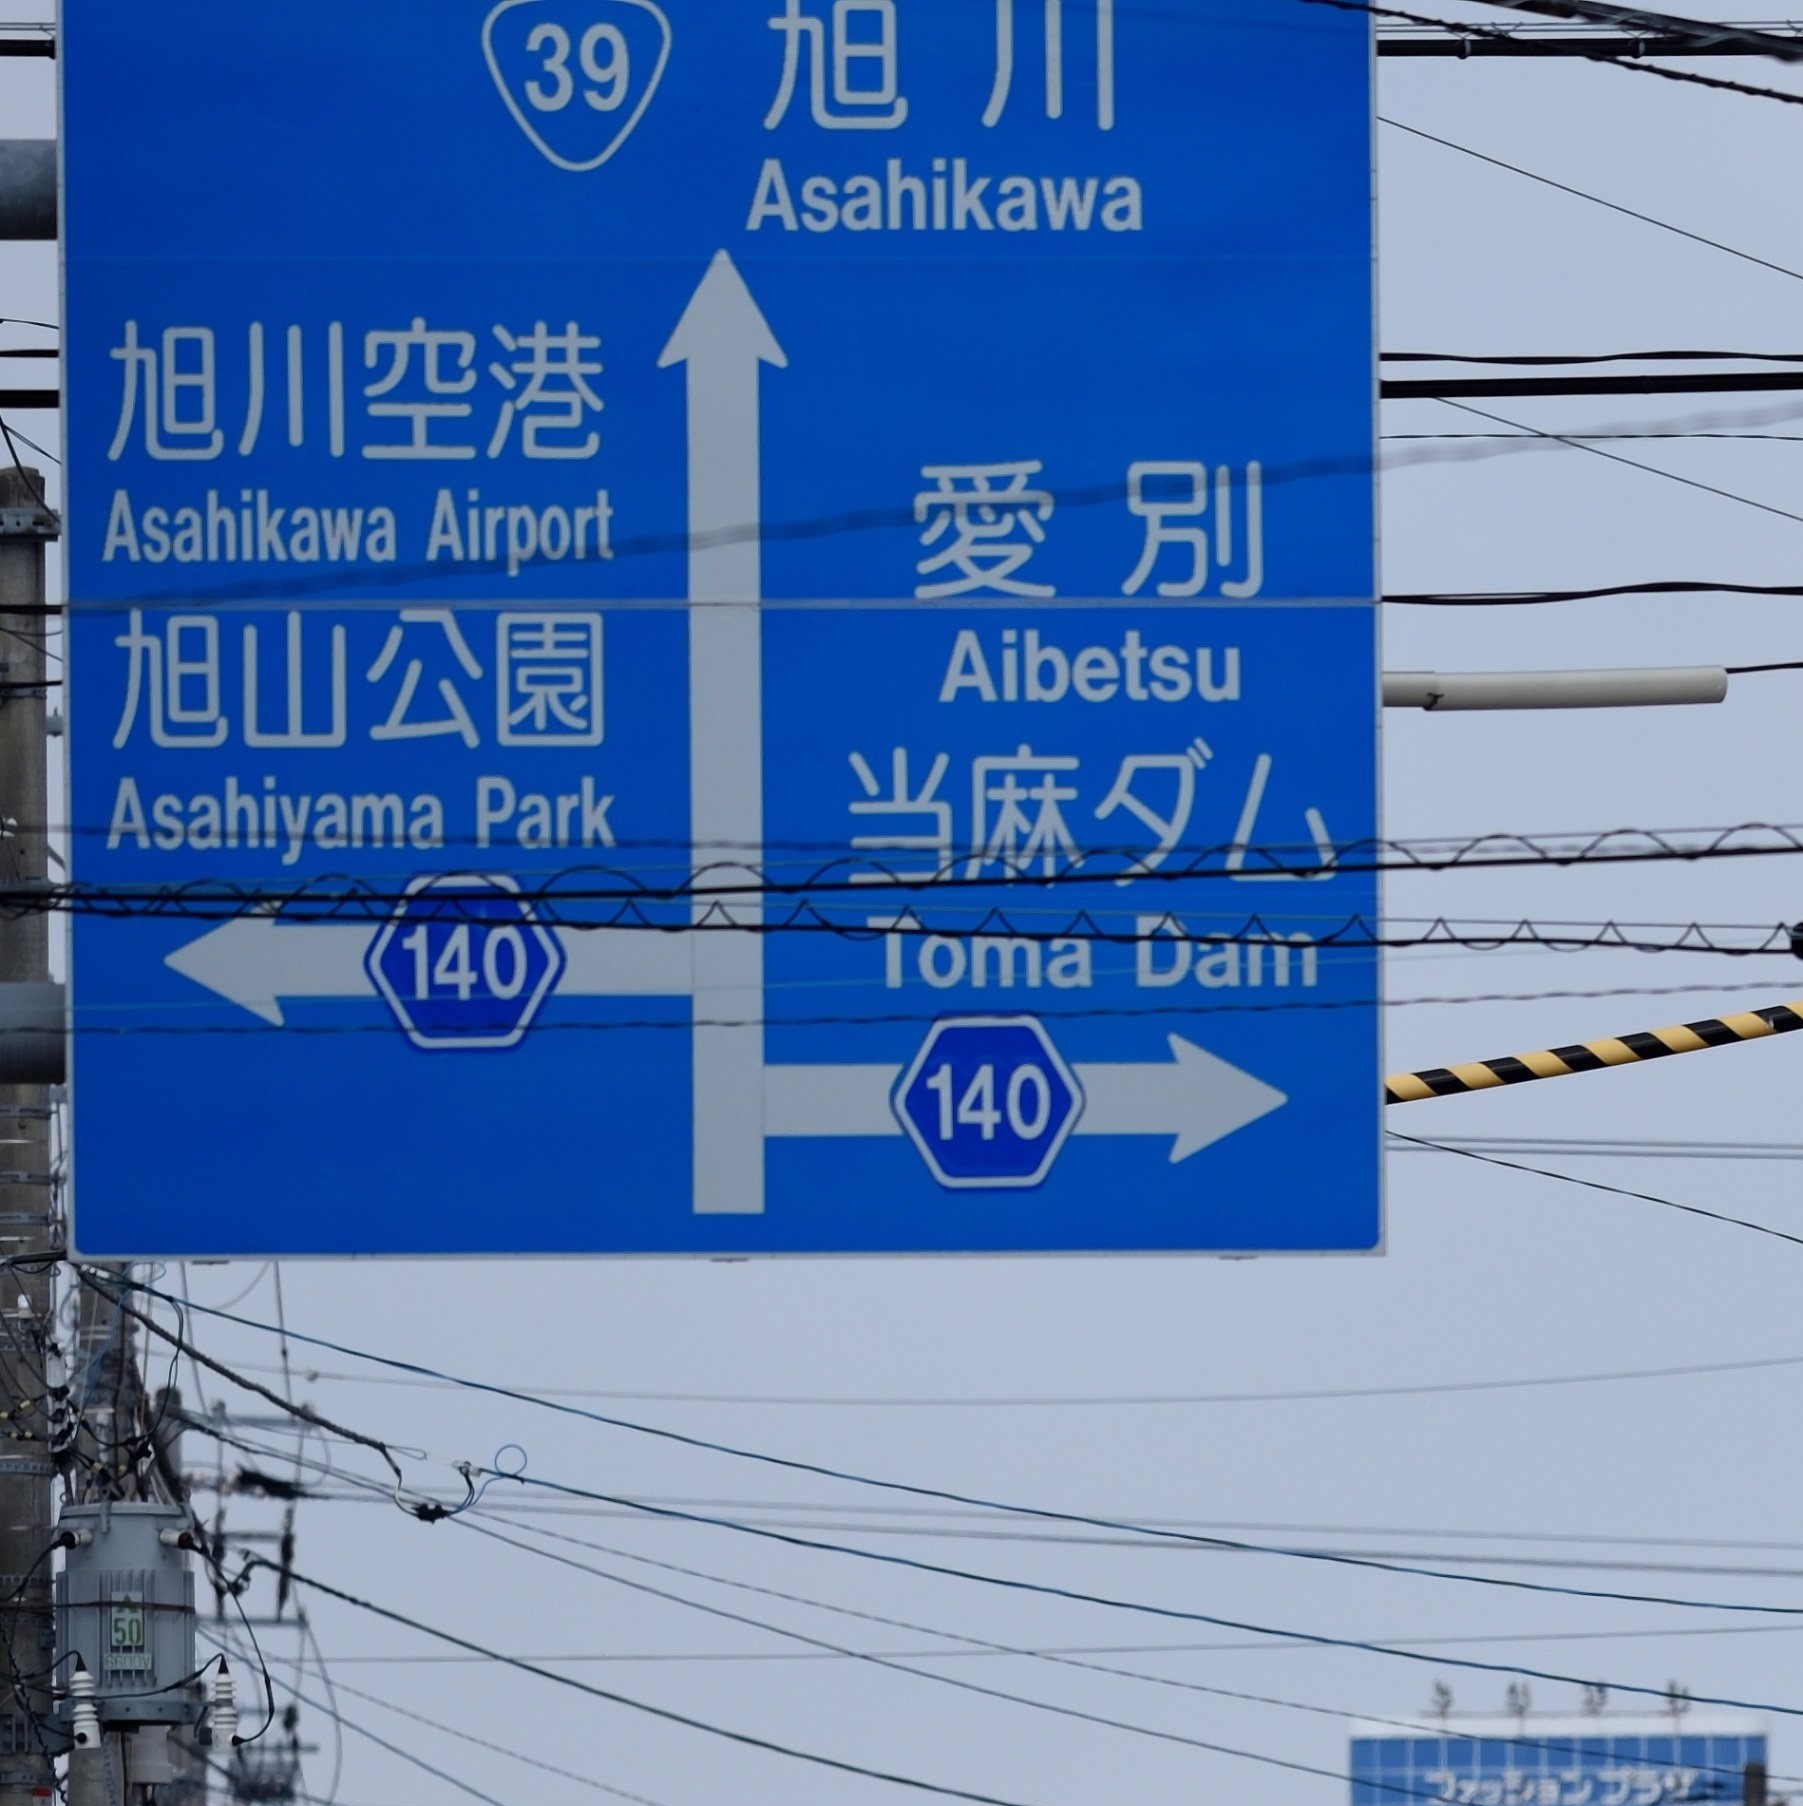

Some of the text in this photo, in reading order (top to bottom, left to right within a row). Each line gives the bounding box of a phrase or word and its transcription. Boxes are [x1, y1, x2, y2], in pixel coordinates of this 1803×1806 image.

[524, 23, 630, 112] 39
[763, 0, 1115, 130] 旭川
[745, 157, 1143, 232] Asahikawa
[107, 318, 603, 461] 旭川空港
[102, 488, 615, 577] Asahikawa Airport
[914, 460, 1264, 598] 愛別
[112, 608, 603, 749] 旭山公園
[938, 629, 1241, 702] Aibetsu
[105, 776, 617, 865] Asahiyama Park
[849, 738, 1337, 888] 当麻ダム
[400, 926, 529, 1001] 140
[866, 914, 1318, 989] Toma Dam
[926, 1062, 1050, 1140] 140
[114, 1617, 142, 1645] 50
